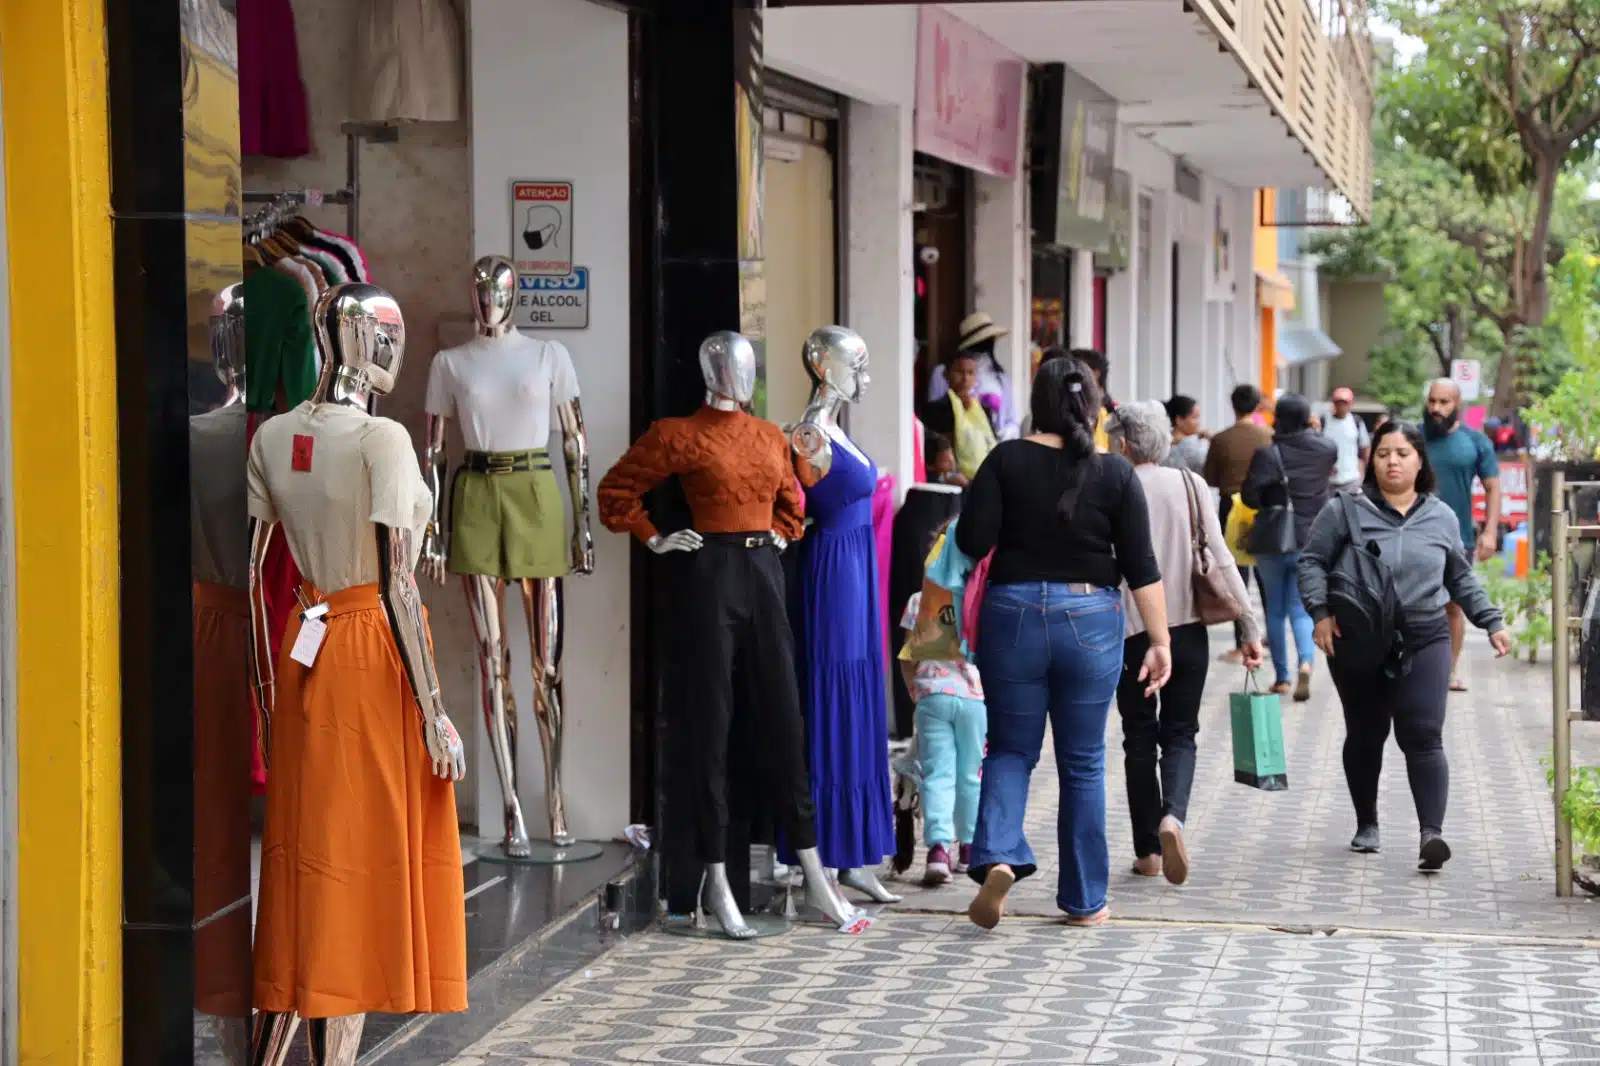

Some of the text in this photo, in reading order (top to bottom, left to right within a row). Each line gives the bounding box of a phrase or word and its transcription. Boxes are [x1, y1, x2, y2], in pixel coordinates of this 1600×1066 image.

[518, 187, 568, 199] ATENÇÃO
[518, 273, 581, 288] VISO
[516, 295, 528, 307] E
[529, 310, 555, 322] GEL
